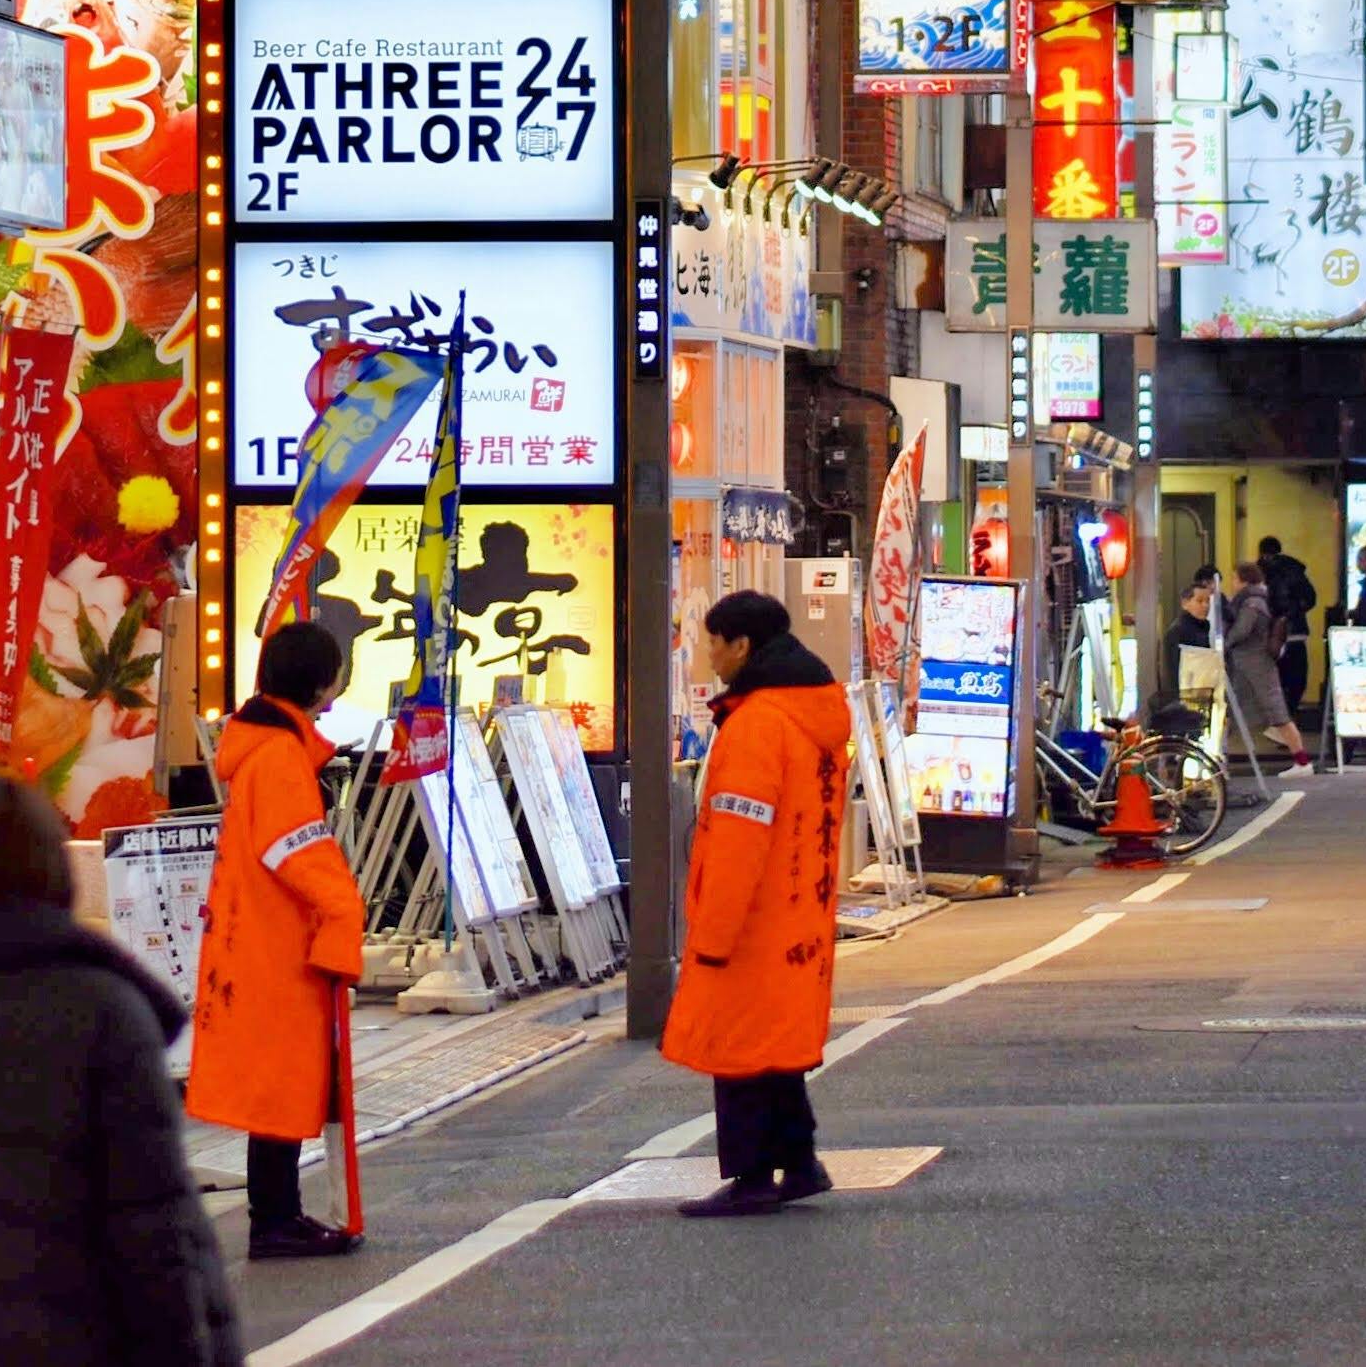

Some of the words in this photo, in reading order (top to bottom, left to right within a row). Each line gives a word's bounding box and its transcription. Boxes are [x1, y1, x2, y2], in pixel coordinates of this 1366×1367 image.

[252, 39, 306, 59] Beer
[314, 38, 367, 59] Cafe
[375, 37, 504, 59] Restaurant
[250, 62, 504, 111] ATHREE
[252, 113, 503, 165] PARLOR
[246, 172, 300, 212] 2F
[272, 253, 339, 278] つきじ
[1325, 261, 1356, 281] 2F
[638, 213, 659, 365] 仲見世通り
[6, 356, 34, 540] アルバイト
[247, 436, 299, 476] 1F
